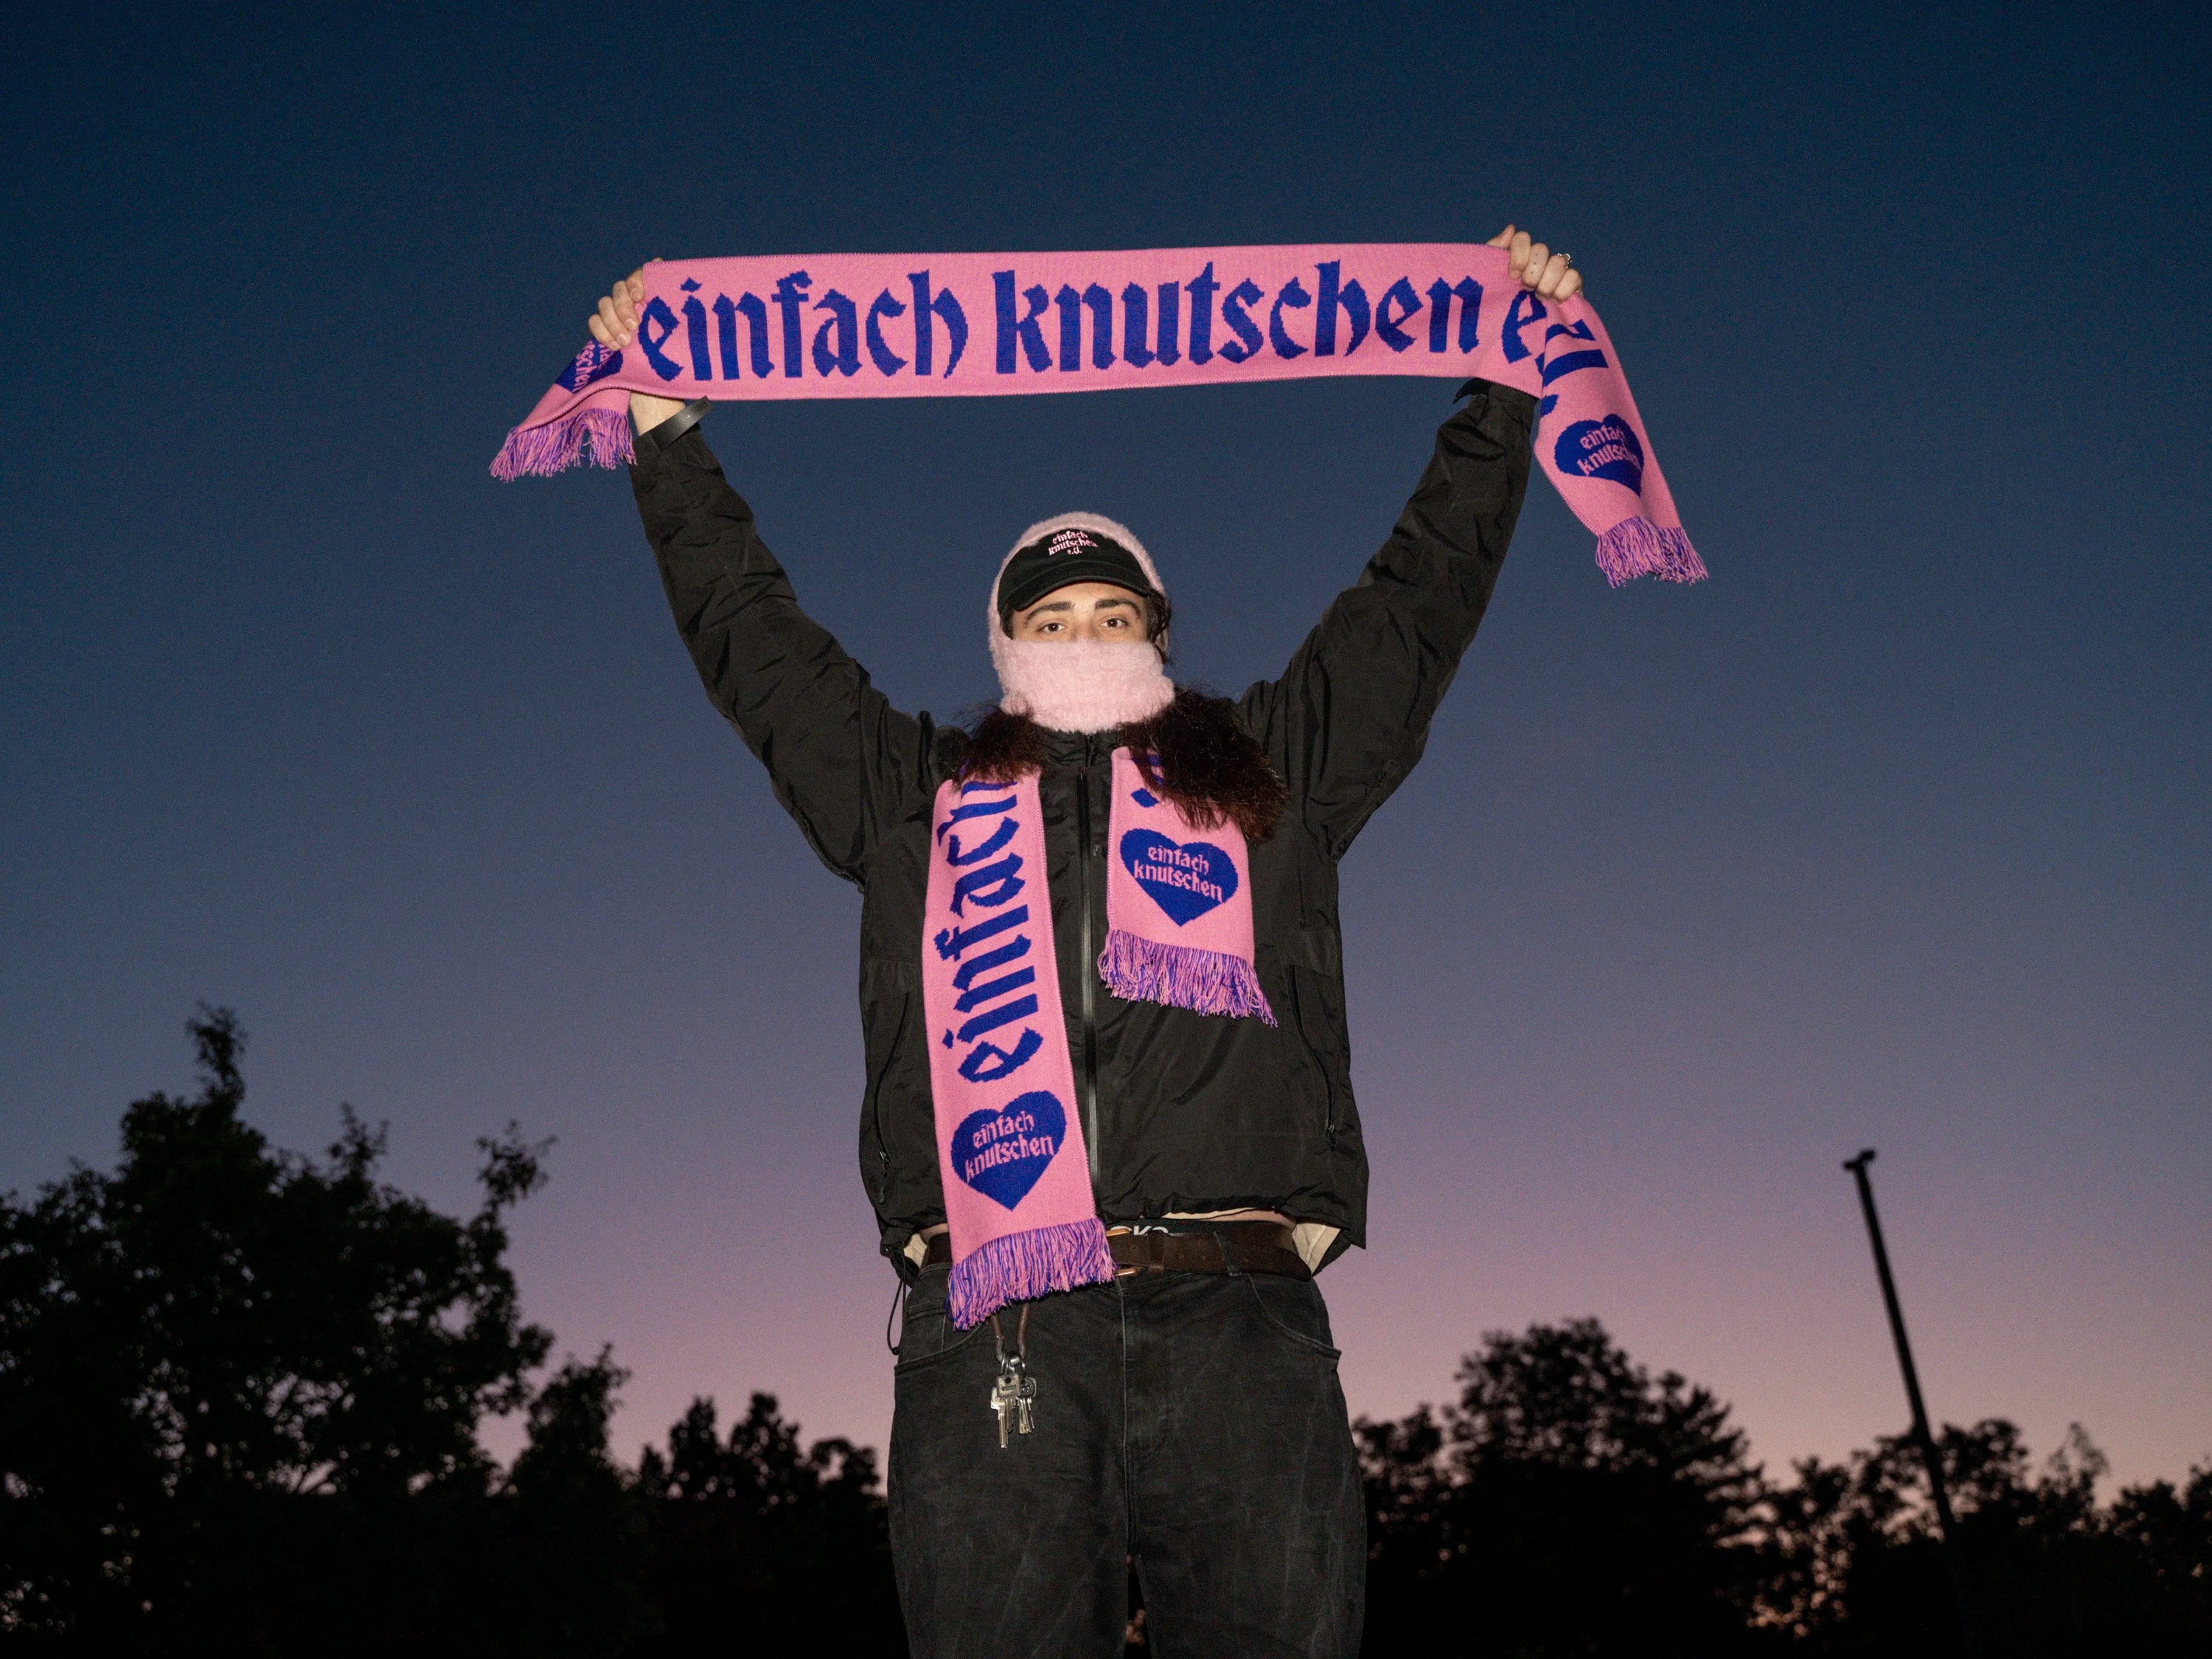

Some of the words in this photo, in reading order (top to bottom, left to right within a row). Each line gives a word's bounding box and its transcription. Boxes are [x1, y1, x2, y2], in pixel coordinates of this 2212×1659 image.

[638, 269, 968, 381] einfach
[992, 260, 1484, 375] knutschen
[1048, 538, 1099, 555] knutschen
[1052, 530, 1088, 544] einfach
[1147, 845, 1209, 875] einfach
[1134, 859, 1222, 902] knutschen
[973, 1110, 1034, 1149] einfach
[965, 1134, 1054, 1183] knutschen
